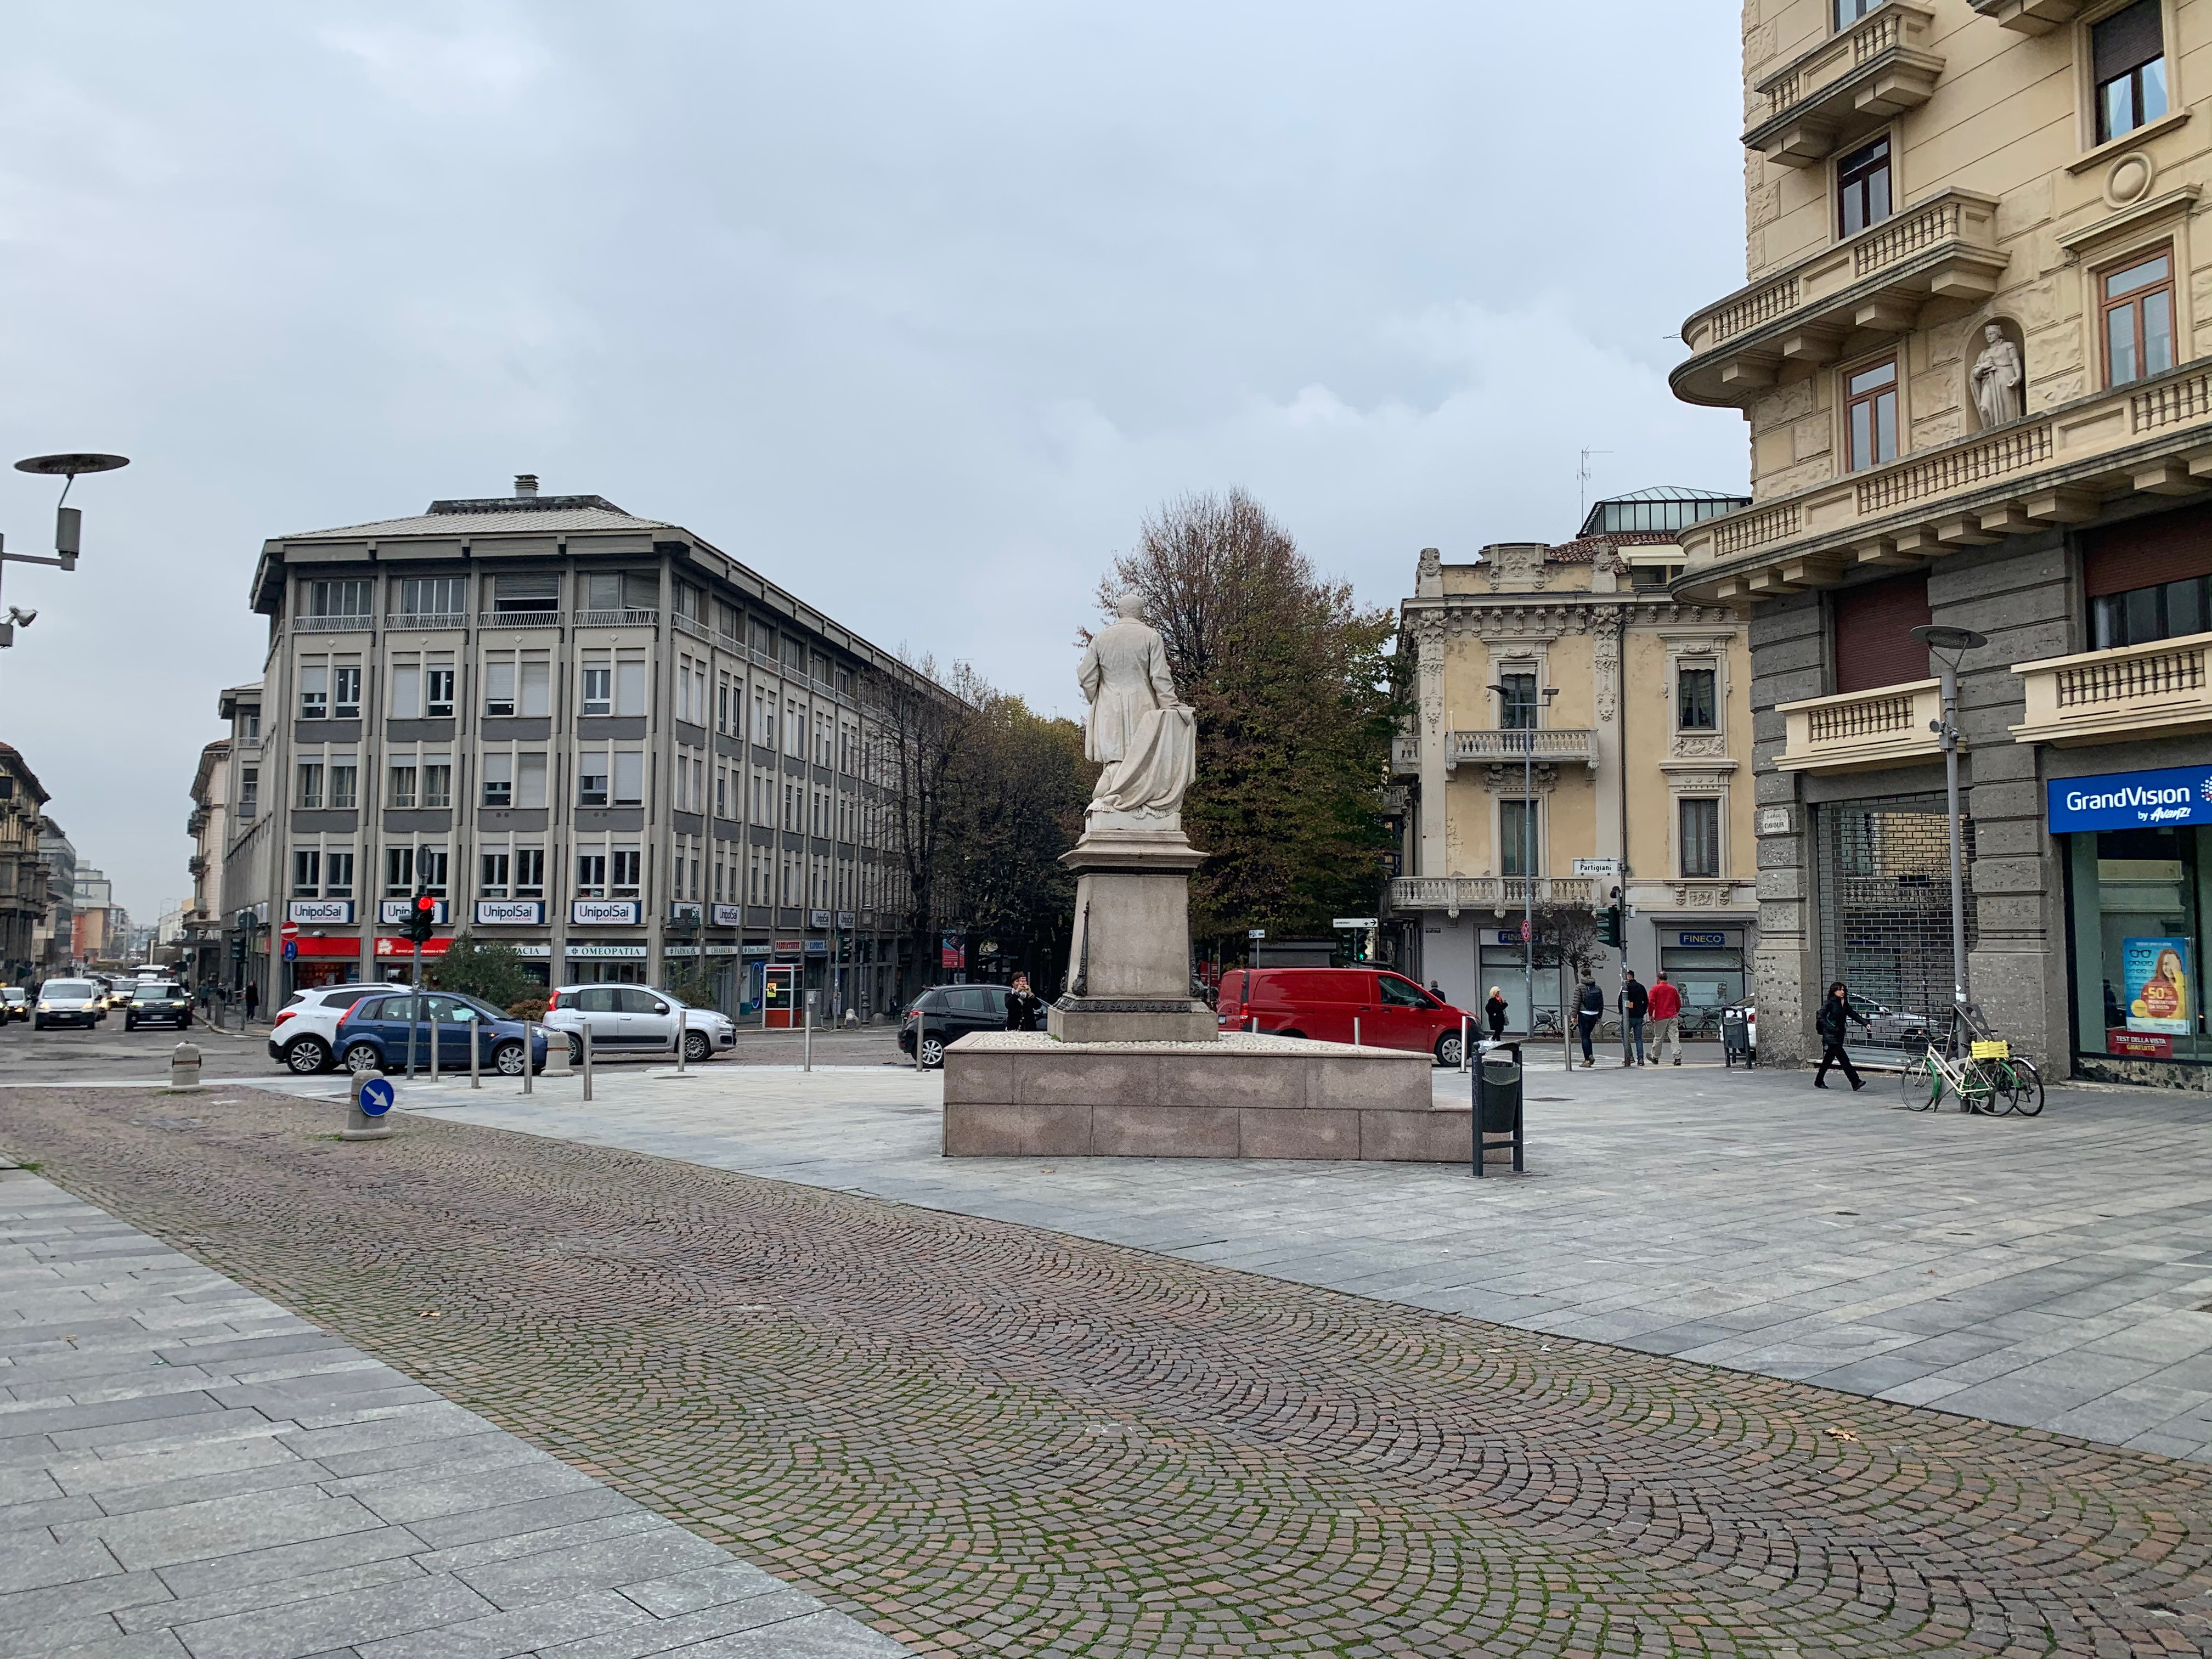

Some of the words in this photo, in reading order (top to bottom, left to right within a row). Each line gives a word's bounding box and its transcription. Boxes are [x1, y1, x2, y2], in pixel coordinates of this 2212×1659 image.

[2066, 786, 2191, 811] GrandVision
[2137, 811, 2148, 822] by
[1580, 864, 1611, 872] Partigiani
[295, 904, 342, 921] UnipolSai
[483, 905, 532, 921] UnipolSai
[579, 905, 629, 921] UnipolSai
[1683, 935, 1722, 943] FINECO
